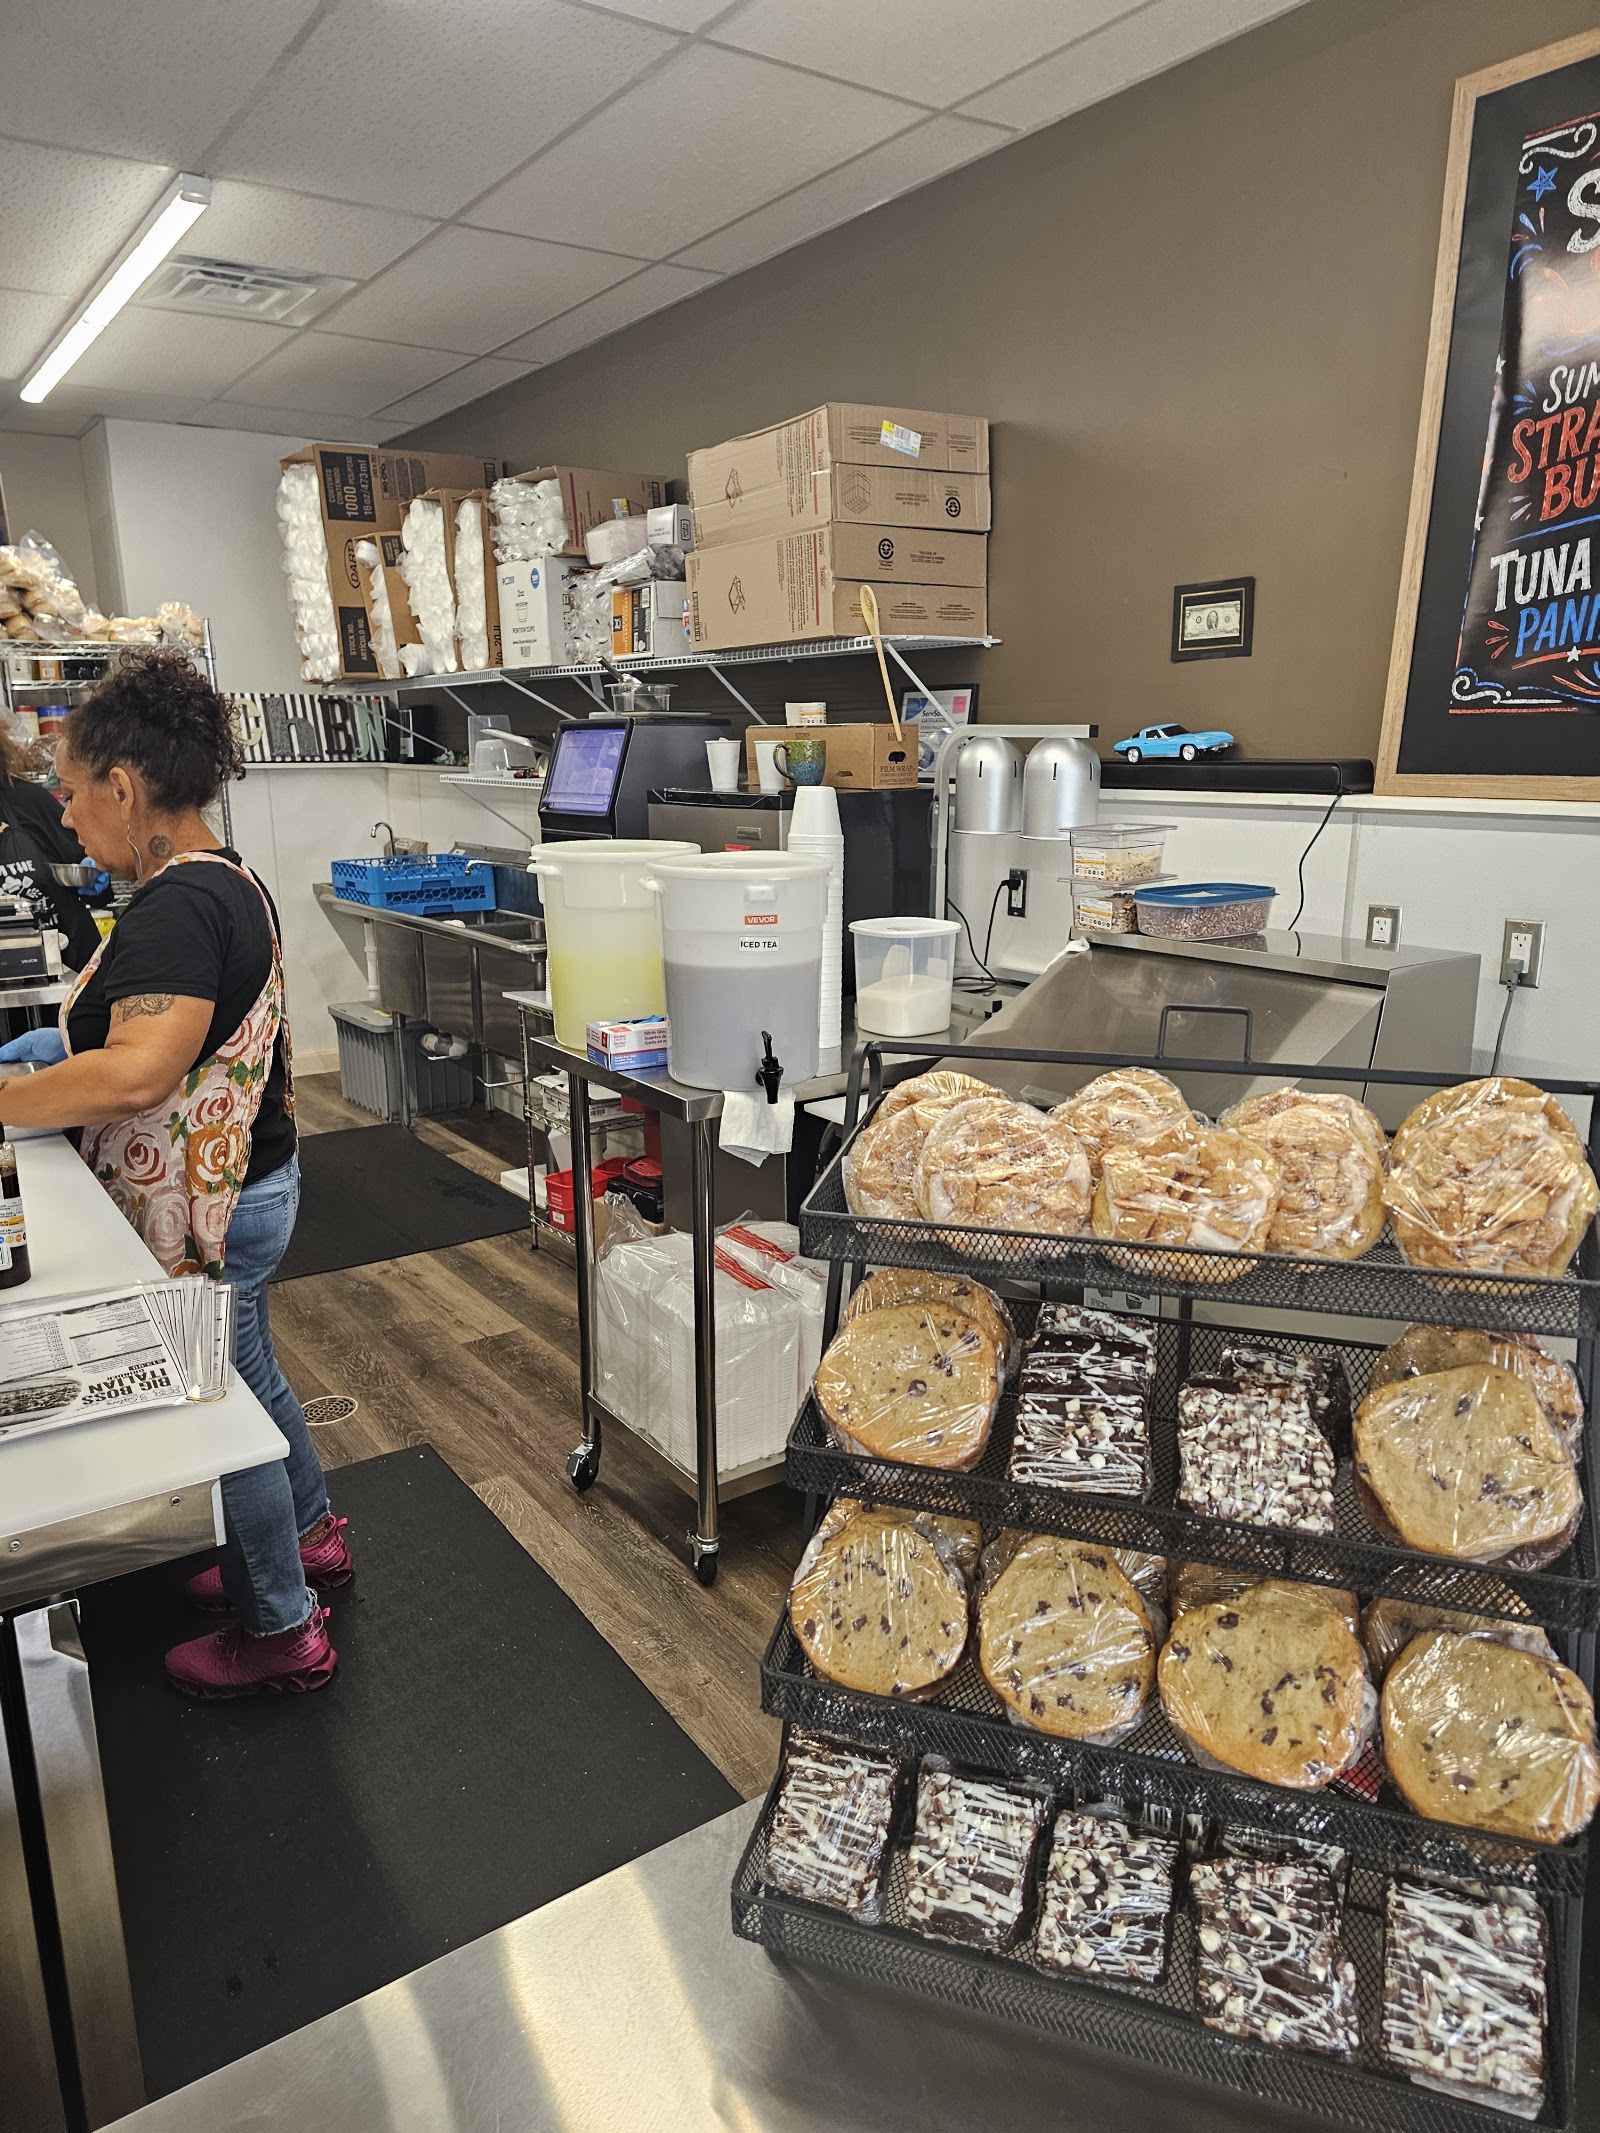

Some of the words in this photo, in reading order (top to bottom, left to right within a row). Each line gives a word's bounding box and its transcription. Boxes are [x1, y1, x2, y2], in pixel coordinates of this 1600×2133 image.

[344, 486, 359, 517] 1000
[348, 547, 359, 583] DART
[1490, 537, 1591, 612] TUNA
[896, 764, 913, 773] WRAP
[6, 859, 36, 876] THE
[747, 916, 776, 924] VEVOR
[88, 1368, 167, 1394] ITALIAN
[139, 1376, 171, 1391] BIG
[82, 1385, 133, 1405] BOSS
